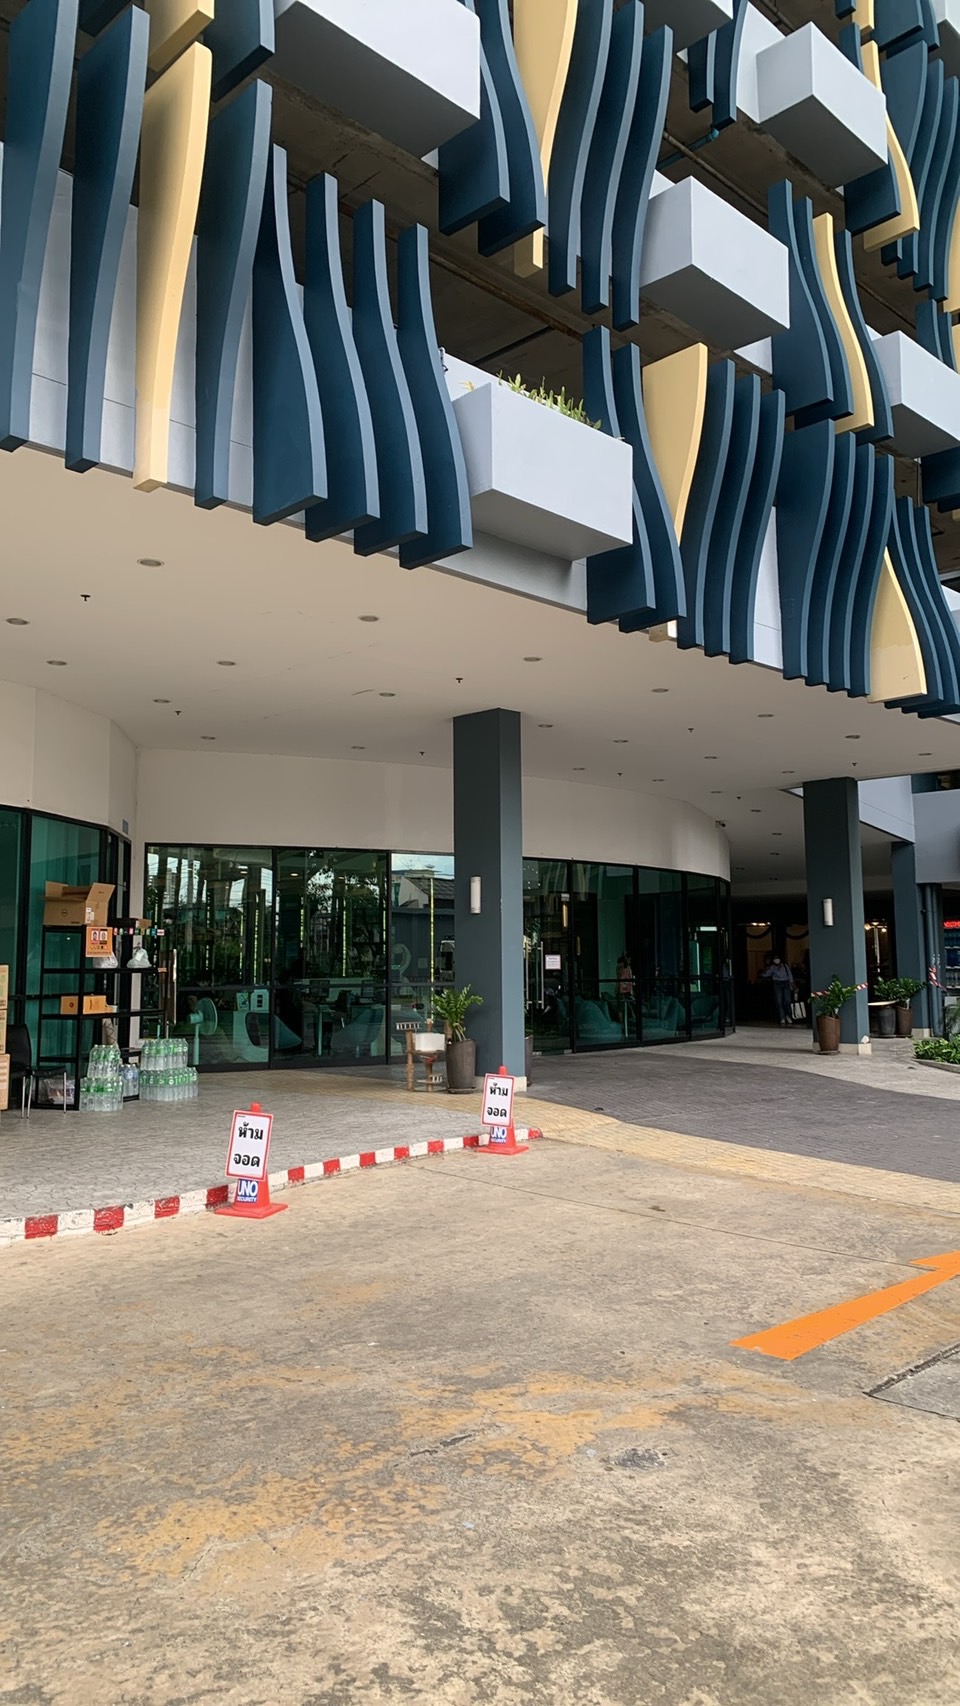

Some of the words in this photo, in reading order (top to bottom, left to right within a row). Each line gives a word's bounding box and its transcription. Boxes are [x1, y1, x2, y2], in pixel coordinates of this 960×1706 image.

[489, 1082, 508, 1096] ห้าม
[487, 1107, 507, 1117] จอด
[238, 1121, 263, 1140] ห้าม
[233, 1153, 260, 1167] จอด
[237, 1180, 258, 1197] UNO
